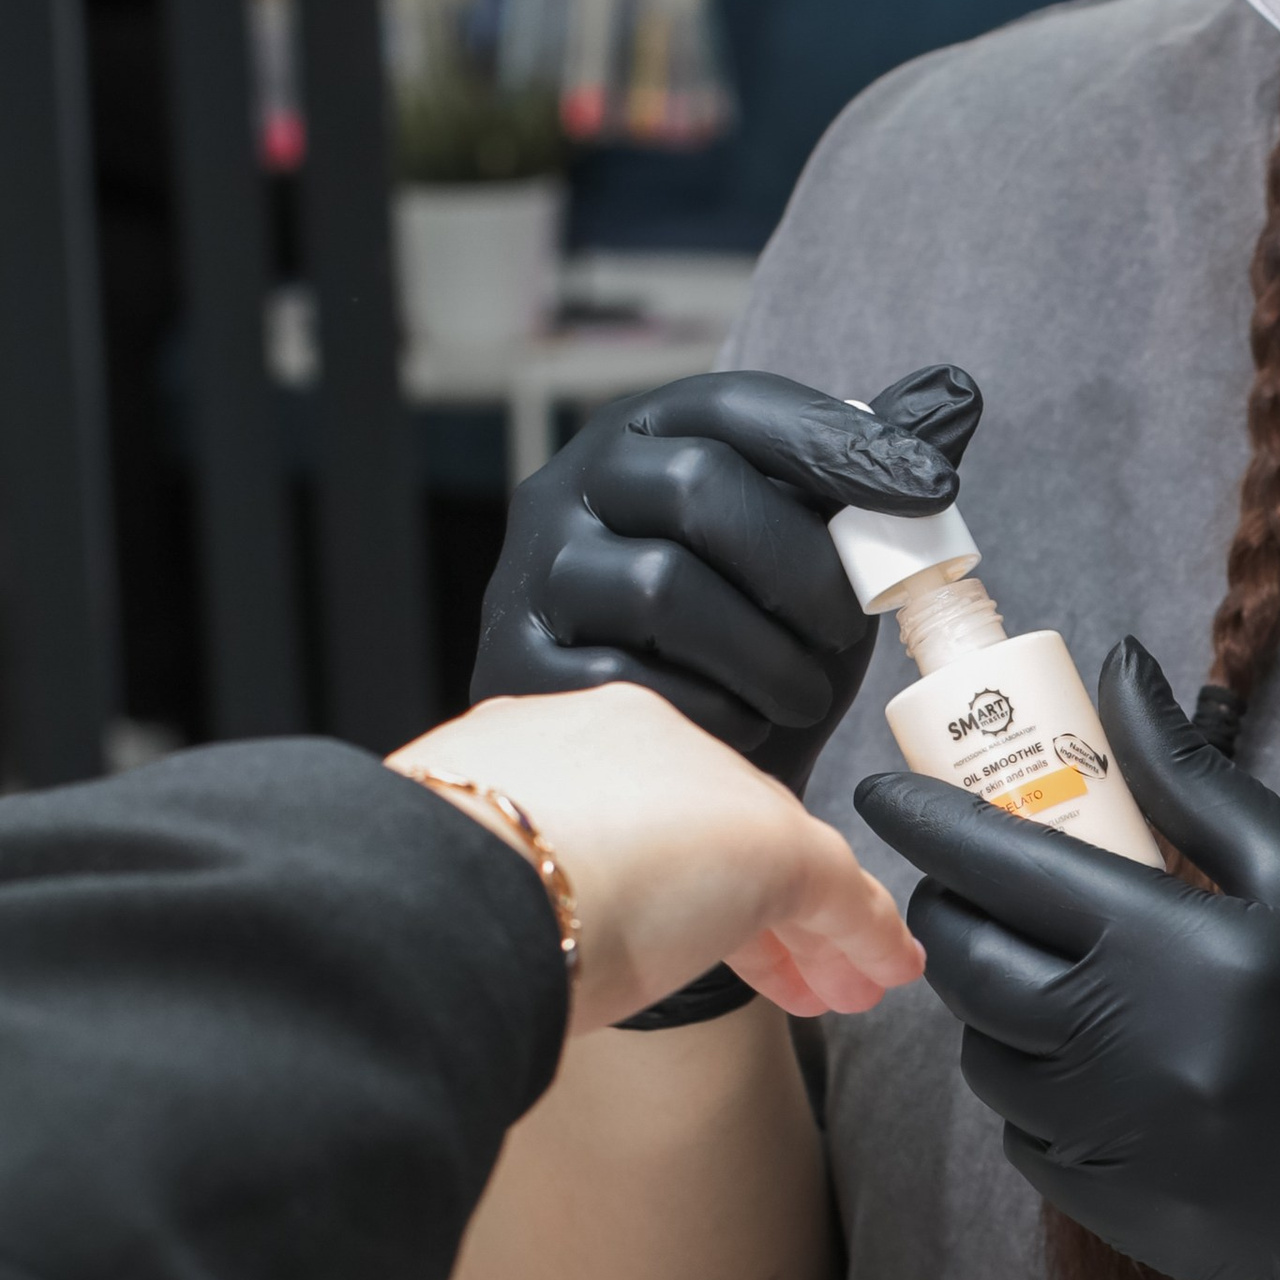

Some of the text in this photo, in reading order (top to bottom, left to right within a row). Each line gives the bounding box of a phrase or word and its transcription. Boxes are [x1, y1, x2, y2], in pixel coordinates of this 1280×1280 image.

[948, 699, 1005, 741] SMART
[980, 711, 1008, 727] master
[963, 742, 1044, 788] OIL SMOOTHIE
[1060, 746, 1100, 774] ingredients
[1069, 741, 1096, 762] Natural
[985, 778, 1004, 794] skin
[1006, 768, 1024, 784] and
[1026, 759, 1048, 775] nails
[1001, 789, 1043, 814] ELATO
